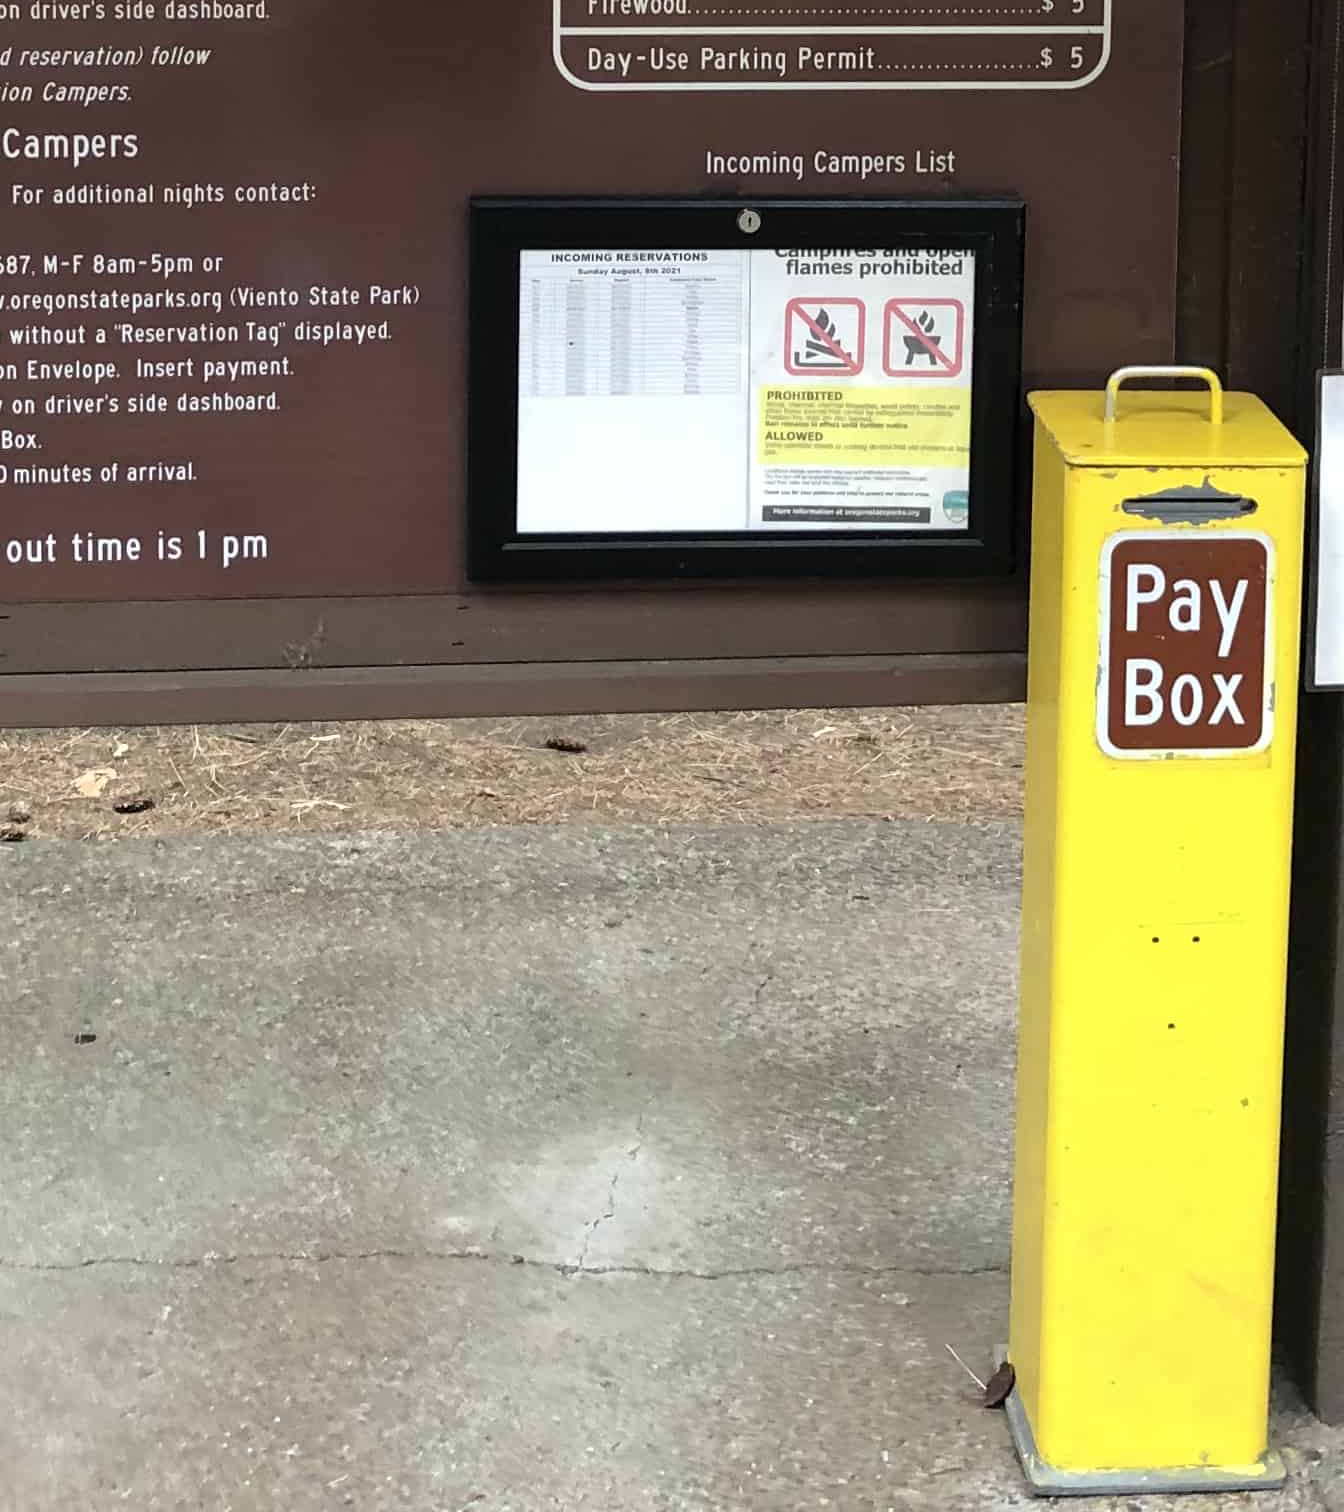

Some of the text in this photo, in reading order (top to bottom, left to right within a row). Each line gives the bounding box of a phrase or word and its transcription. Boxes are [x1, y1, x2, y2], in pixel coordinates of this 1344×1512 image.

[588, 46, 875, 77] Day-Use Parking Permit
[2, 128, 138, 168] Campers
[706, 150, 956, 181] Incoming Campers List
[43, 254, 84, 275] M-F
[93, 253, 193, 279] 8am-5pm
[202, 256, 223, 273] or
[551, 252, 708, 263] INCOMING RESERVATIONS
[785, 258, 963, 279] flames prohibited
[230, 287, 299, 307] (Viento
[308, 286, 360, 306] State
[370, 285, 420, 305] Park)
[9, 325, 86, 345] without
[95, 328, 106, 344] a
[114, 322, 239, 343] "Reservation
[245, 321, 286, 347] Tag"
[294, 320, 392, 346] displayed.
[767, 390, 843, 401] PROHIBITED
[765, 431, 824, 442] ALLOWED
[71, 532, 141, 562] time
[158, 530, 182, 561] is
[197, 529, 206, 559] 1
[223, 535, 268, 569] pm
[1125, 563, 1249, 658] Pay
[1124, 658, 1245, 726] Box
